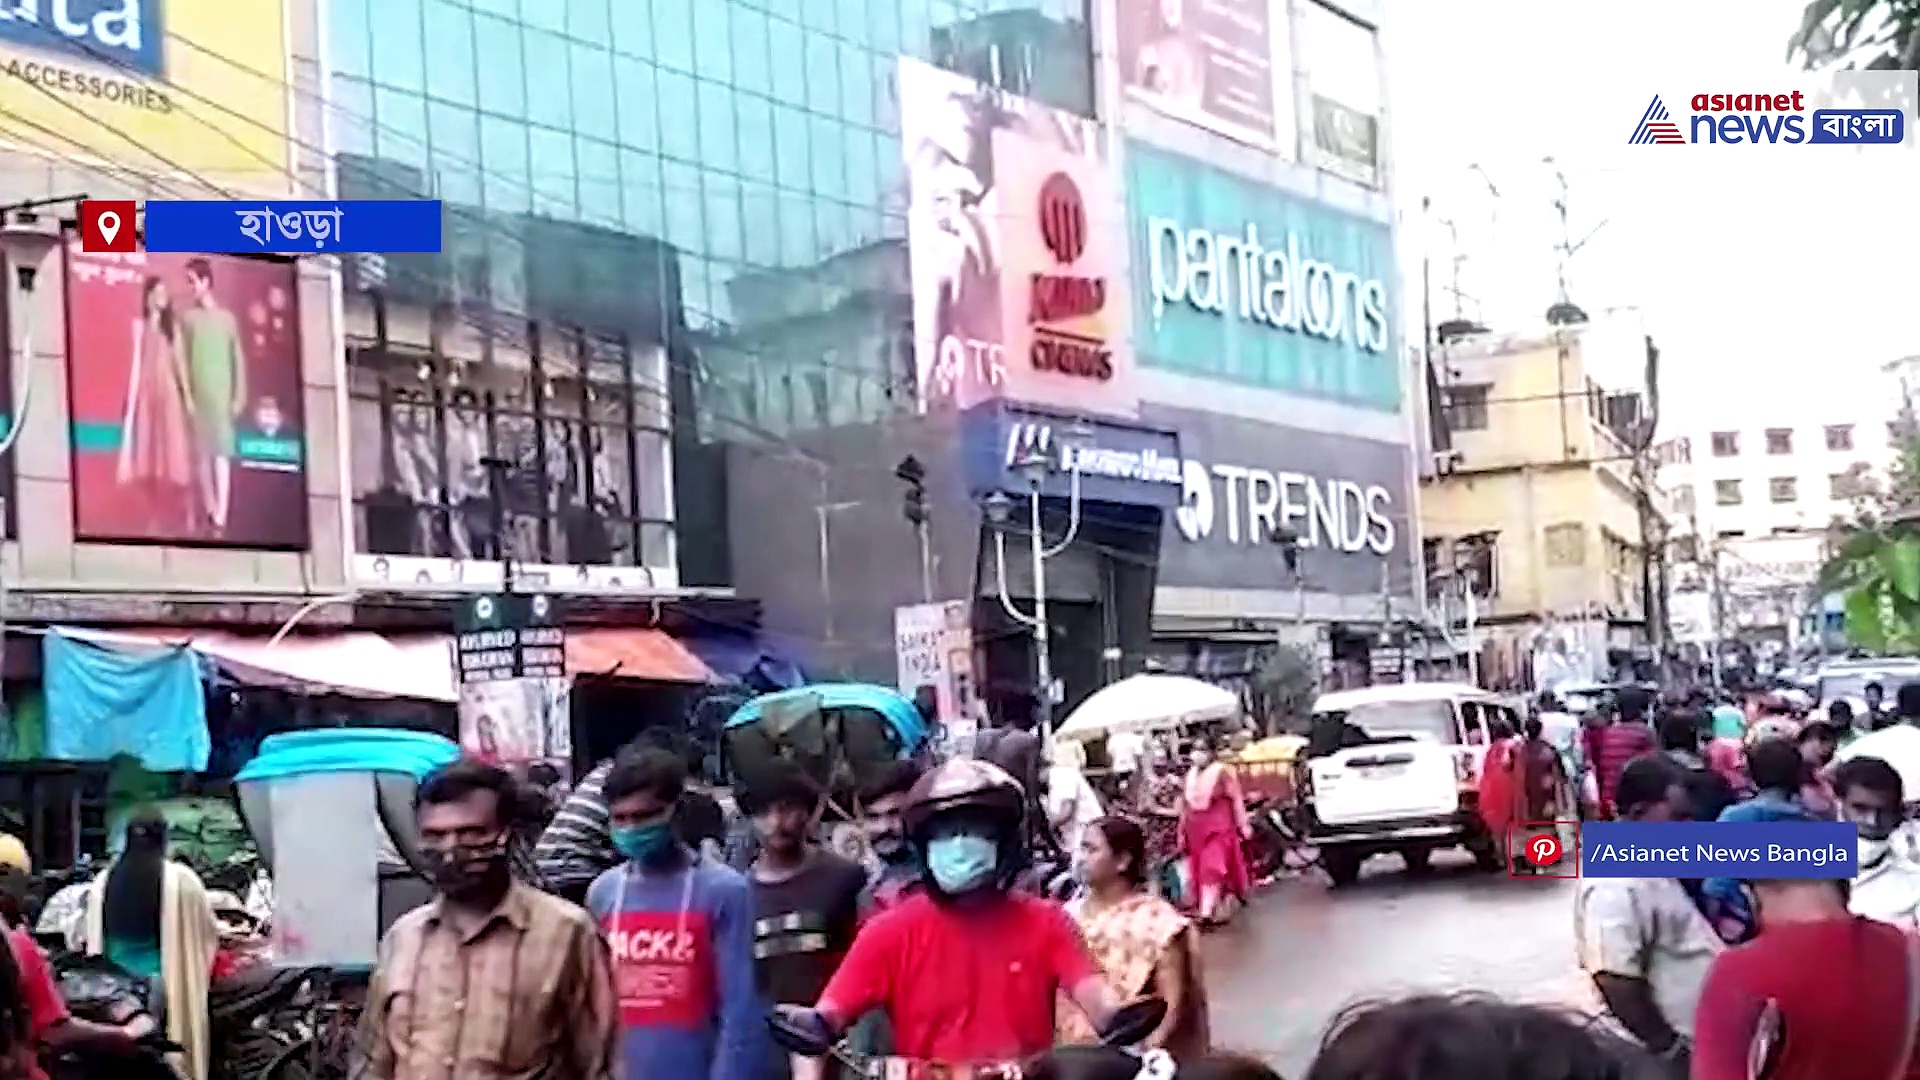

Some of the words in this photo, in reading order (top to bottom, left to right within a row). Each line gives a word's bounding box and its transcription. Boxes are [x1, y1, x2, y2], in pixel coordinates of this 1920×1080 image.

[7, 59, 173, 113] ACCESSORIES
[1149, 217, 1387, 351] pantaloons
[1212, 464, 1394, 554] TRENDS
